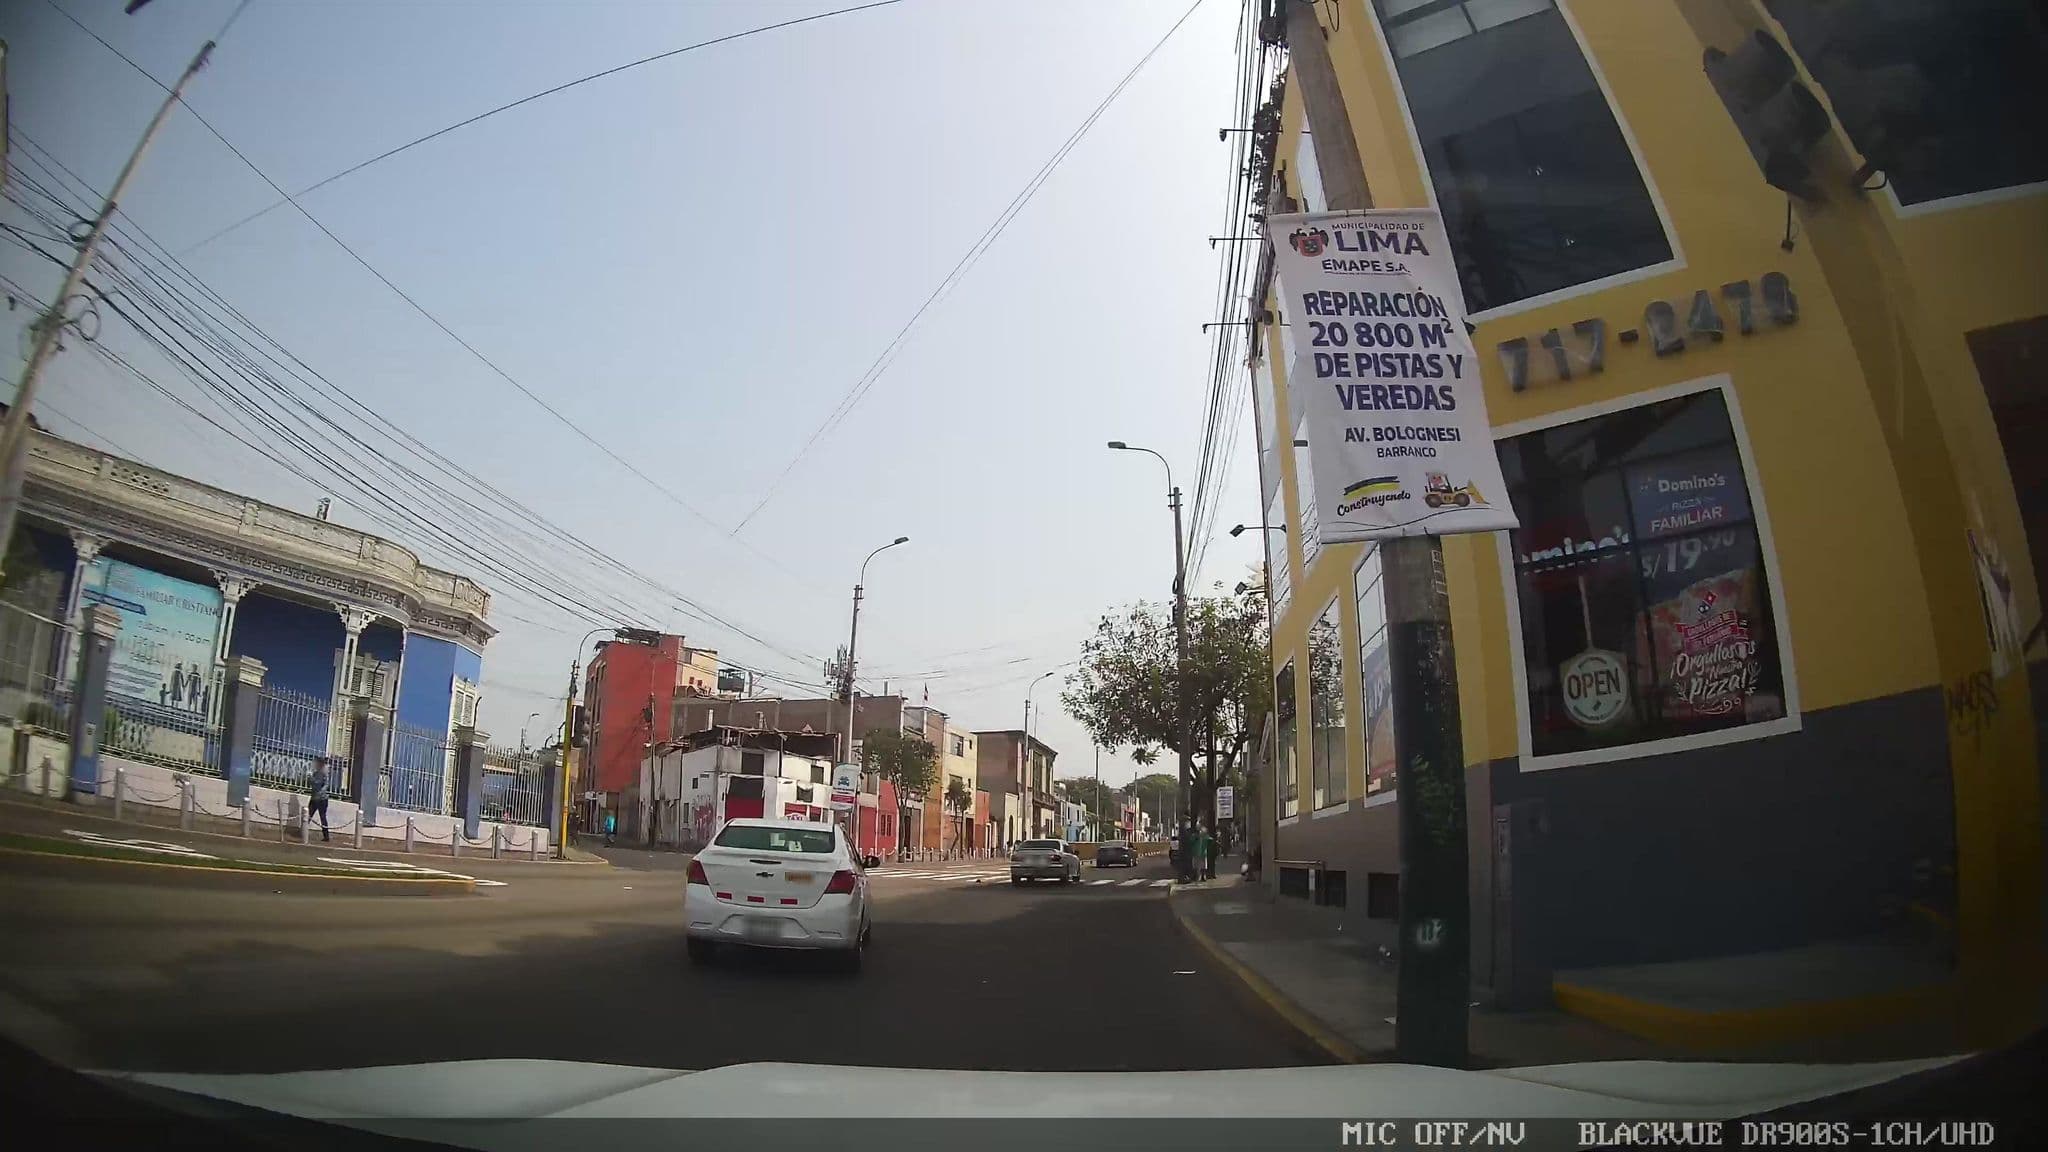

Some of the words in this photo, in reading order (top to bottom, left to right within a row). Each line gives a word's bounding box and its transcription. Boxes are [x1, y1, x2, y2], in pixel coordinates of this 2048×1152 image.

[1331, 222, 1411, 231] MUNICIPALIDAD
[1412, 223, 1425, 231] DE
[1333, 230, 1430, 256] LIMA
[1321, 259, 1381, 273] EMAPE
[1385, 261, 1411, 273] S.A.
[1302, 286, 1448, 318] REPARACIÓN
[1308, 321, 1348, 347] 20
[1355, 322, 1414, 348] 800
[1314, 353, 1350, 379] DE
[1355, 353, 1445, 379] PISTAS
[1446, 354, 1463, 379] Y
[1335, 384, 1456, 411] VEREDAS
[1344, 427, 1370, 443] AV.
[1372, 426, 1461, 443] BOLOGNESI
[1377, 447, 1437, 458] BARRANCO
[1658, 472, 1726, 493] Domino's
[1336, 490, 1411, 517] Construyendo
[1650, 505, 1723, 533] FAMILIAR
[1566, 668, 1622, 701] OPEN
